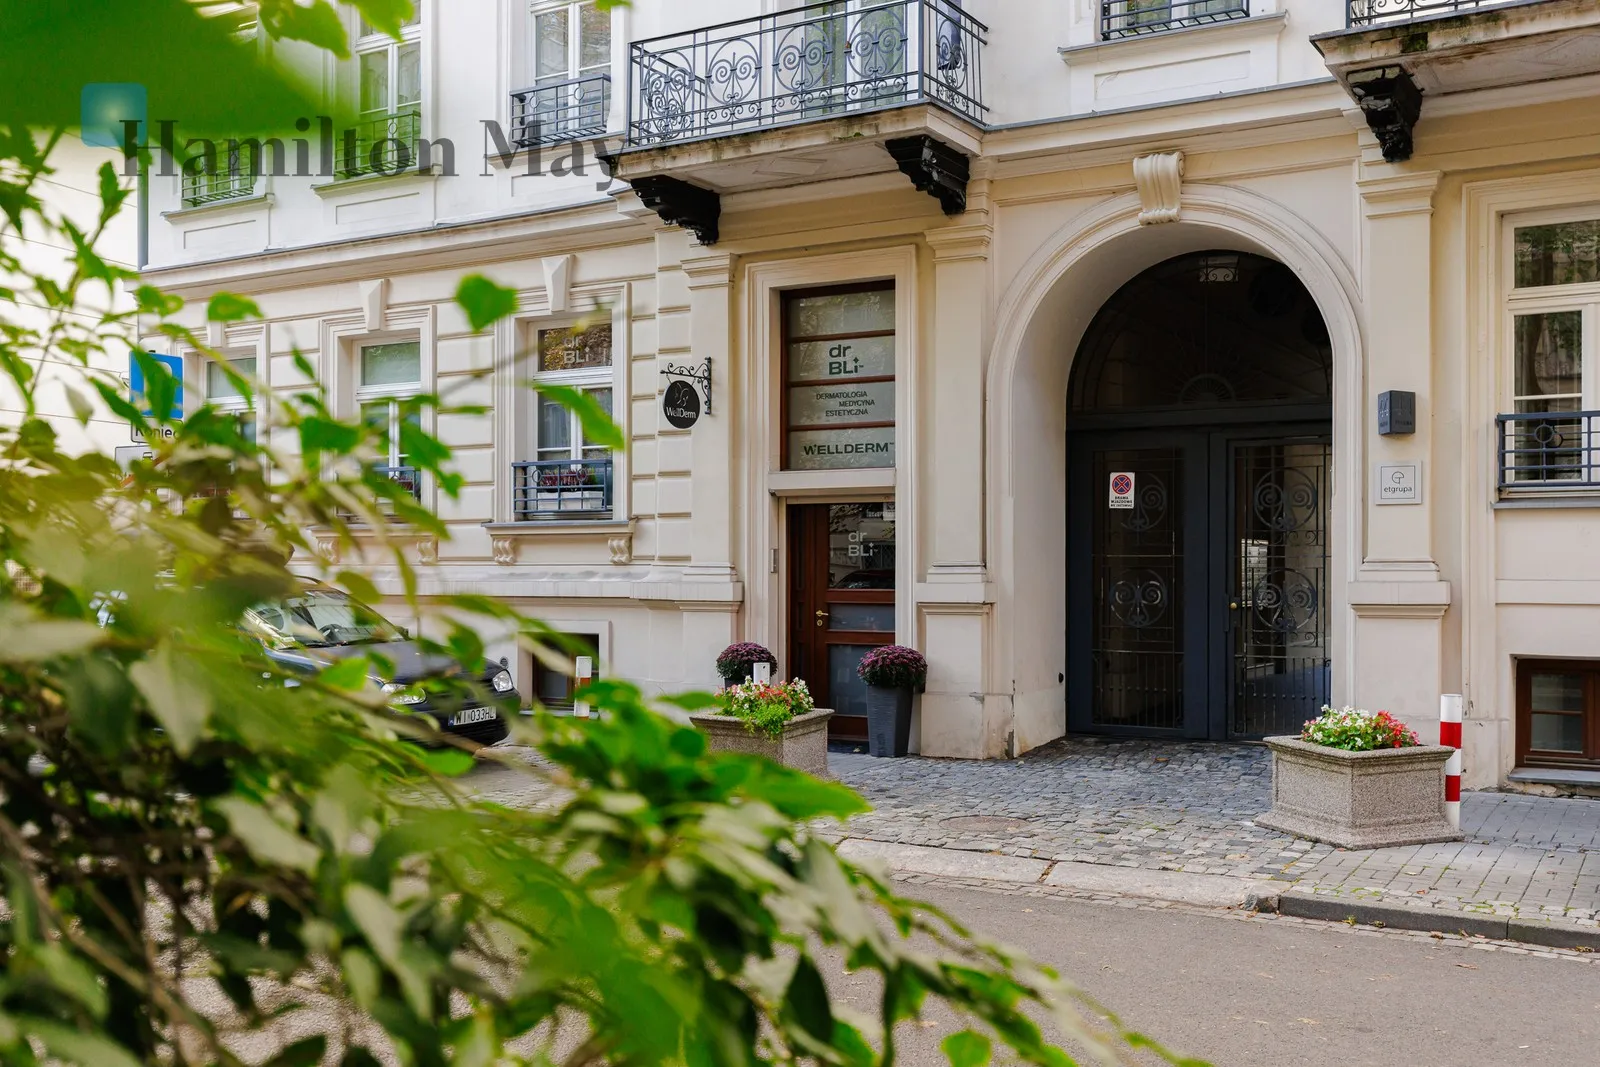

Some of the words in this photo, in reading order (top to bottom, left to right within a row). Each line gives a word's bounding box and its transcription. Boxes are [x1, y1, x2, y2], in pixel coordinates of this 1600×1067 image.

[828, 344, 852, 358] dr
[815, 391, 868, 400] DERMATOLOGIA
[838, 399, 875, 408] MEDYCYNA
[665, 406, 697, 419] WellDerm
[825, 408, 869, 417] ESTETYCZNA
[1383, 486, 1413, 494] etgrupa
[848, 531, 867, 542] dr
